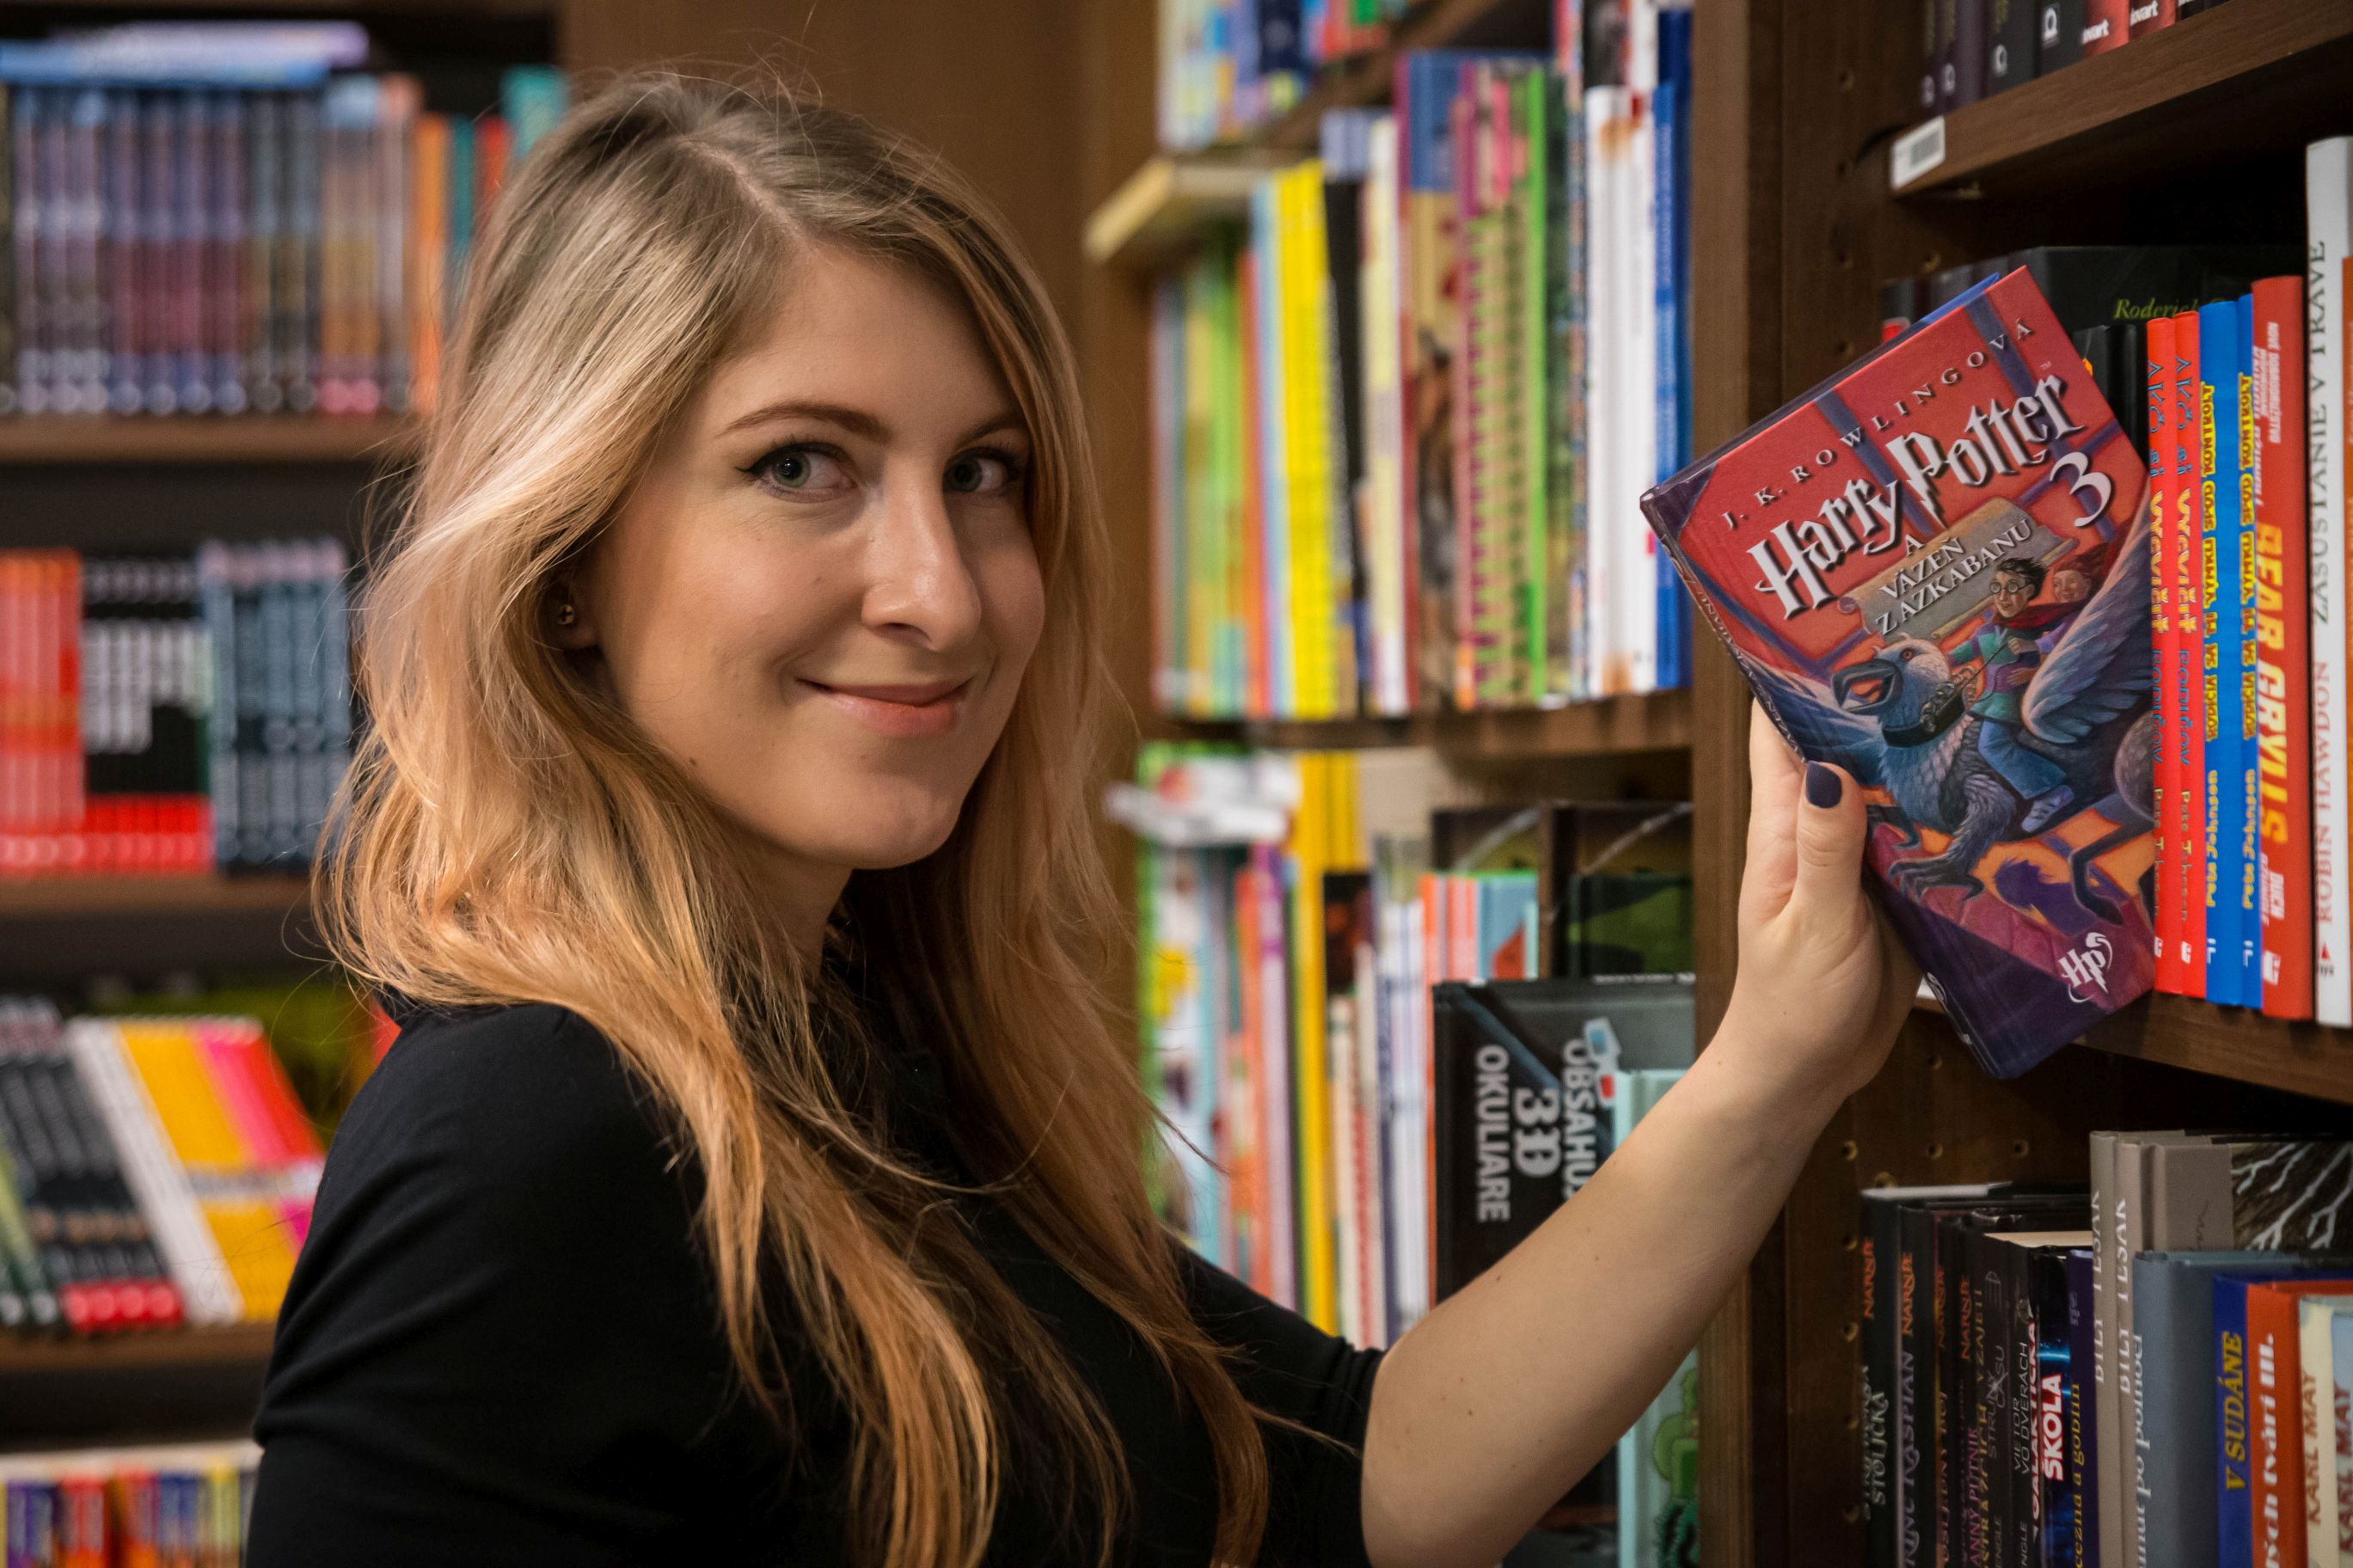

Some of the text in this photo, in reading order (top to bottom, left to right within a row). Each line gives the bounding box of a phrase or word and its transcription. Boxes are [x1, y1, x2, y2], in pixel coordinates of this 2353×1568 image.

[1722, 320, 2034, 531] J. K. ROWLINGOVÁ
[1746, 475, 1908, 621] Harry
[1885, 373, 2086, 529] Potter
[2050, 451, 2112, 527] 3
[1876, 518, 2035, 636] Z AZKABANU
[1879, 536, 1967, 601] VÄZEŇ
[1903, 534, 1926, 556] A
[2255, 522, 2289, 844] BEAR GRYLLS
[2314, 661, 2333, 923] ROBIN HAWDON
[1475, 1044, 1510, 1223] OKULIARE
[1513, 1088, 1562, 1178] 3D
[2217, 1330, 2246, 1491] V SUDÁNE
[2301, 1367, 2321, 1526] KARL MAY
[2332, 1381, 2352, 1458] MAY
